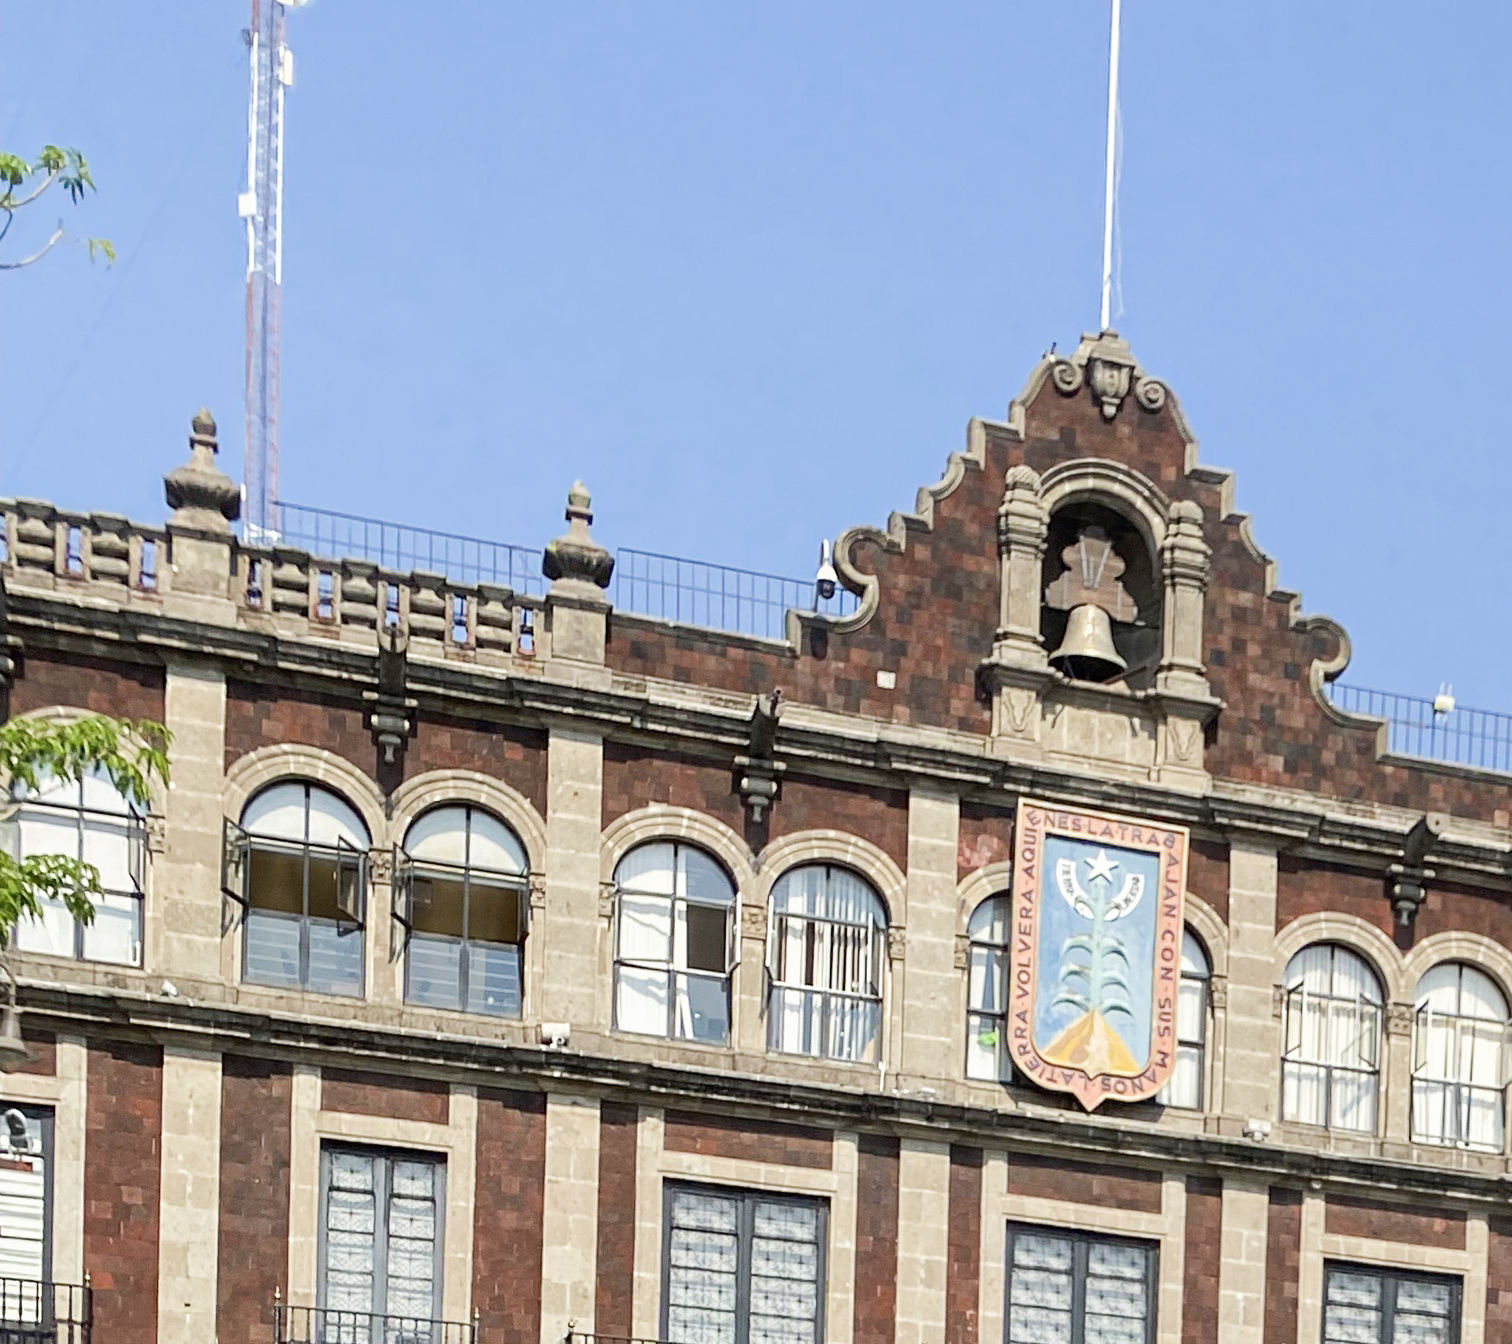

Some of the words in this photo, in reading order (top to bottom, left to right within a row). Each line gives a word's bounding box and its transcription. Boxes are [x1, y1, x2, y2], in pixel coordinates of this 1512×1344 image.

[1016, 888, 1034, 999] VOLVERA
[1160, 929, 1176, 982] CON
[1158, 997, 1173, 1037] SUS
[1100, 1050, 1170, 1094] MANOS
